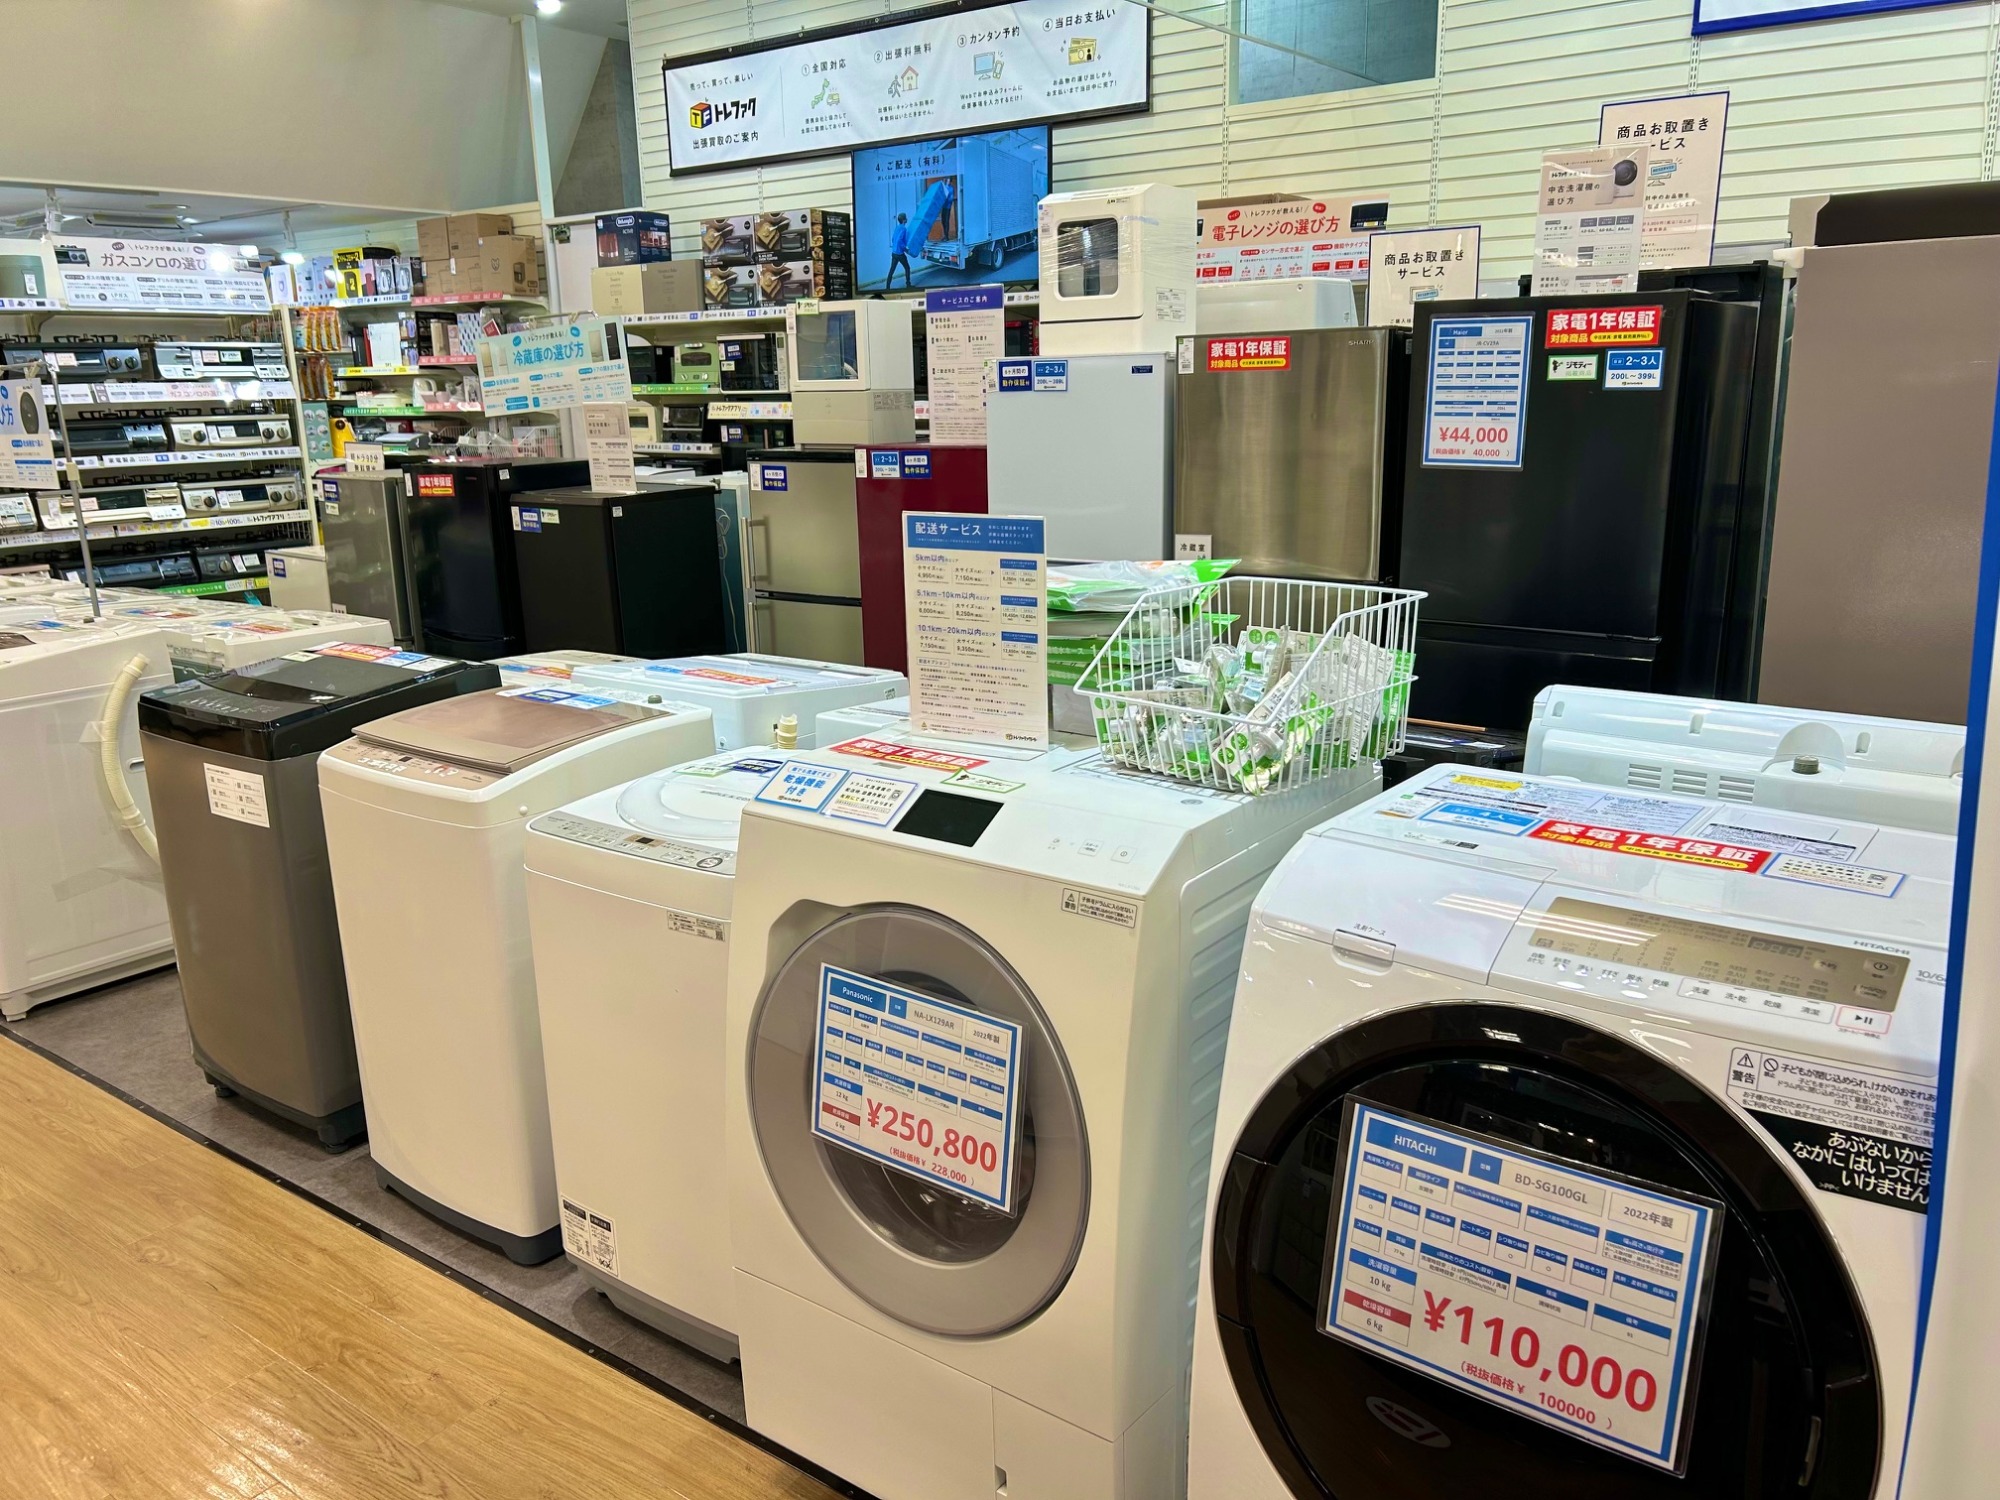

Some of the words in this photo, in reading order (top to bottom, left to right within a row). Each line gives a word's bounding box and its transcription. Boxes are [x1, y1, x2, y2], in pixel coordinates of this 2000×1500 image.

[715, 97, 757, 122] トレファク
[1617, 117, 1709, 140] 商品お取置き
[692, 131, 759, 150] 出張買取のご案内
[1548, 182, 1600, 194] 中古洗濯機の
[1547, 197, 1575, 206] 選び方
[1212, 215, 1340, 242] 電子レンジの選び方
[100, 252, 227, 272] ガスコンロの選び
[1385, 250, 1464, 266] 商品お取置き
[1398, 266, 1445, 280] サービス
[1552, 310, 1656, 331] 家電1年保証
[1550, 333, 1589, 344] 対象商品
[513, 341, 585, 367] 冷蔵庫の選び方
[1211, 340, 1287, 358] 家電1年保証
[1439, 426, 1509, 445] ¥44,000
[1473, 448, 1500, 457] 40,000
[915, 521, 981, 536] 配送サービス
[783, 774, 827, 789] 乾燥機能
[786, 787, 807, 797] 付き
[1539, 831, 1614, 849] 対象商品
[1549, 822, 1758, 863] 家電1年保証
[1853, 940, 1910, 956] HITACHI
[842, 986, 873, 1003] Panasonic
[914, 1009, 955, 1031] NA-LX129AR
[973, 1029, 1000, 1046] 2022年製
[1732, 1070, 1756, 1085] 警告
[835, 1090, 843, 1099] 12
[866, 1097, 997, 1173] ¥250,800
[1393, 1134, 1437, 1158] HITACHI
[1828, 1131, 1933, 1167] あぶないから
[931, 1162, 968, 1185] 228,000
[1514, 1172, 1589, 1205] BD-SG100GL
[1842, 1172, 1930, 1205] いけません
[1623, 1205, 1674, 1229] 2022年製
[1461, 1222, 1491, 1237] ヒートポンプ
[1367, 1257, 1397, 1276] 洗濯容量
[1369, 1275, 1380, 1287] 10
[1381, 1279, 1392, 1292] kg
[1362, 1298, 1392, 1318] 乾燥容量
[1366, 1317, 1372, 1326] 6
[1373, 1320, 1384, 1333] kg
[1423, 1289, 1658, 1413] ¥110,000
[1538, 1392, 1596, 1425] 100000
